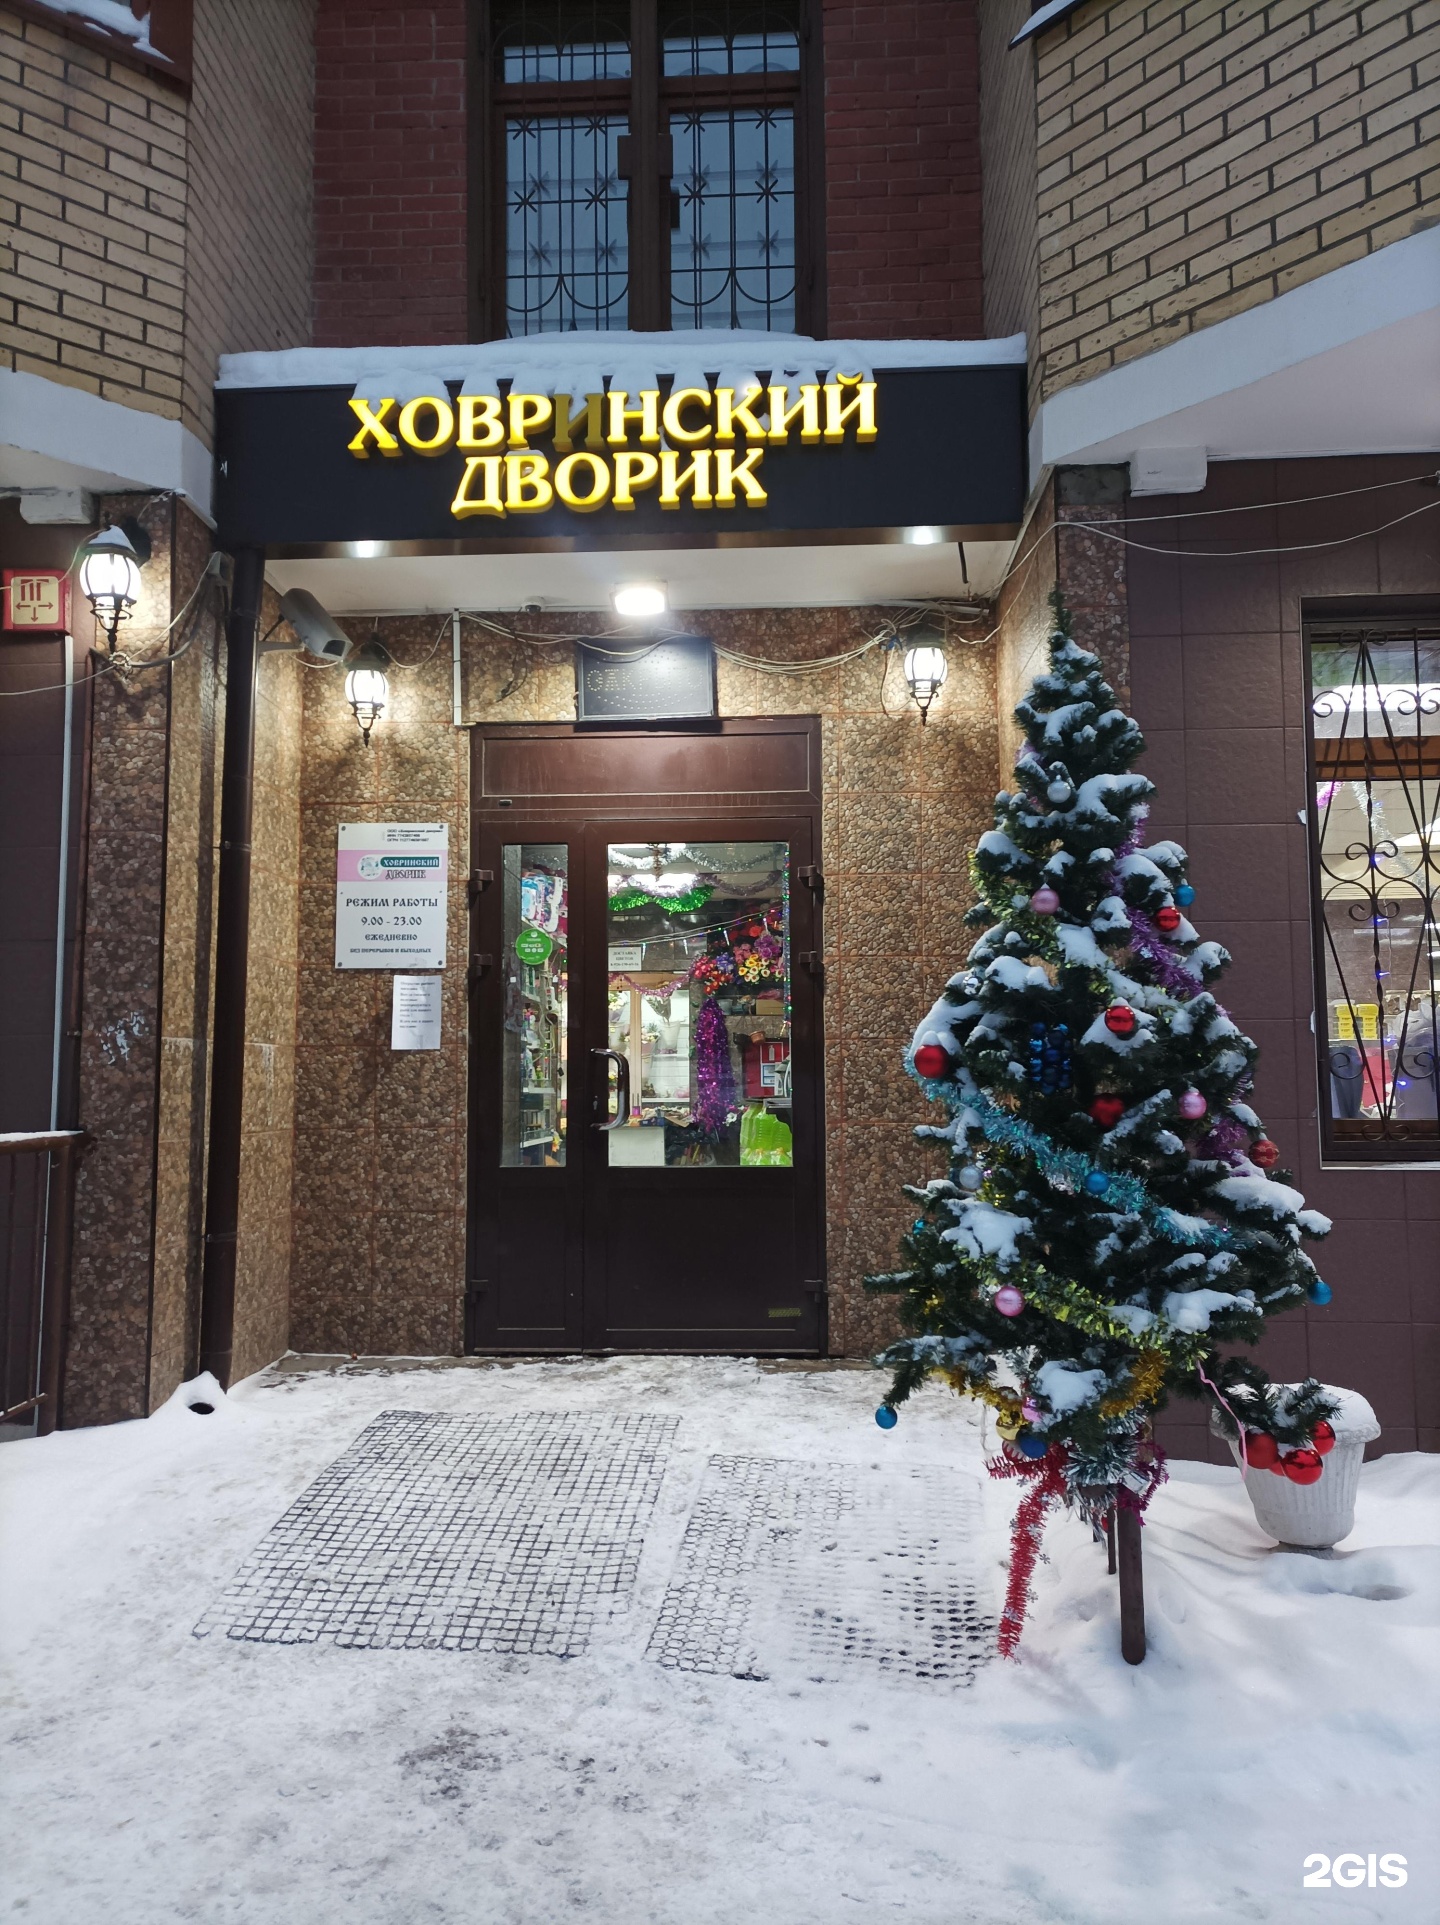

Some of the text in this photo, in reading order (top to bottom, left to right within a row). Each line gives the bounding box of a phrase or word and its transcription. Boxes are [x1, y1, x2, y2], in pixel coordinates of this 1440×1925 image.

[348, 372, 878, 458] ХОВРИНСКИЙ
[451, 448, 768, 520] ДВОРИК
[384, 858, 439, 867] ХОВРИНСКИЙ
[385, 870, 426, 880] ДВОРИК
[346, 898, 438, 907] РЕЖИМ РАБОТЫ
[361, 916, 384, 926] 9.00
[393, 916, 422, 926] 23.00
[364, 934, 418, 942] ЕЖЕДНЕВНО
